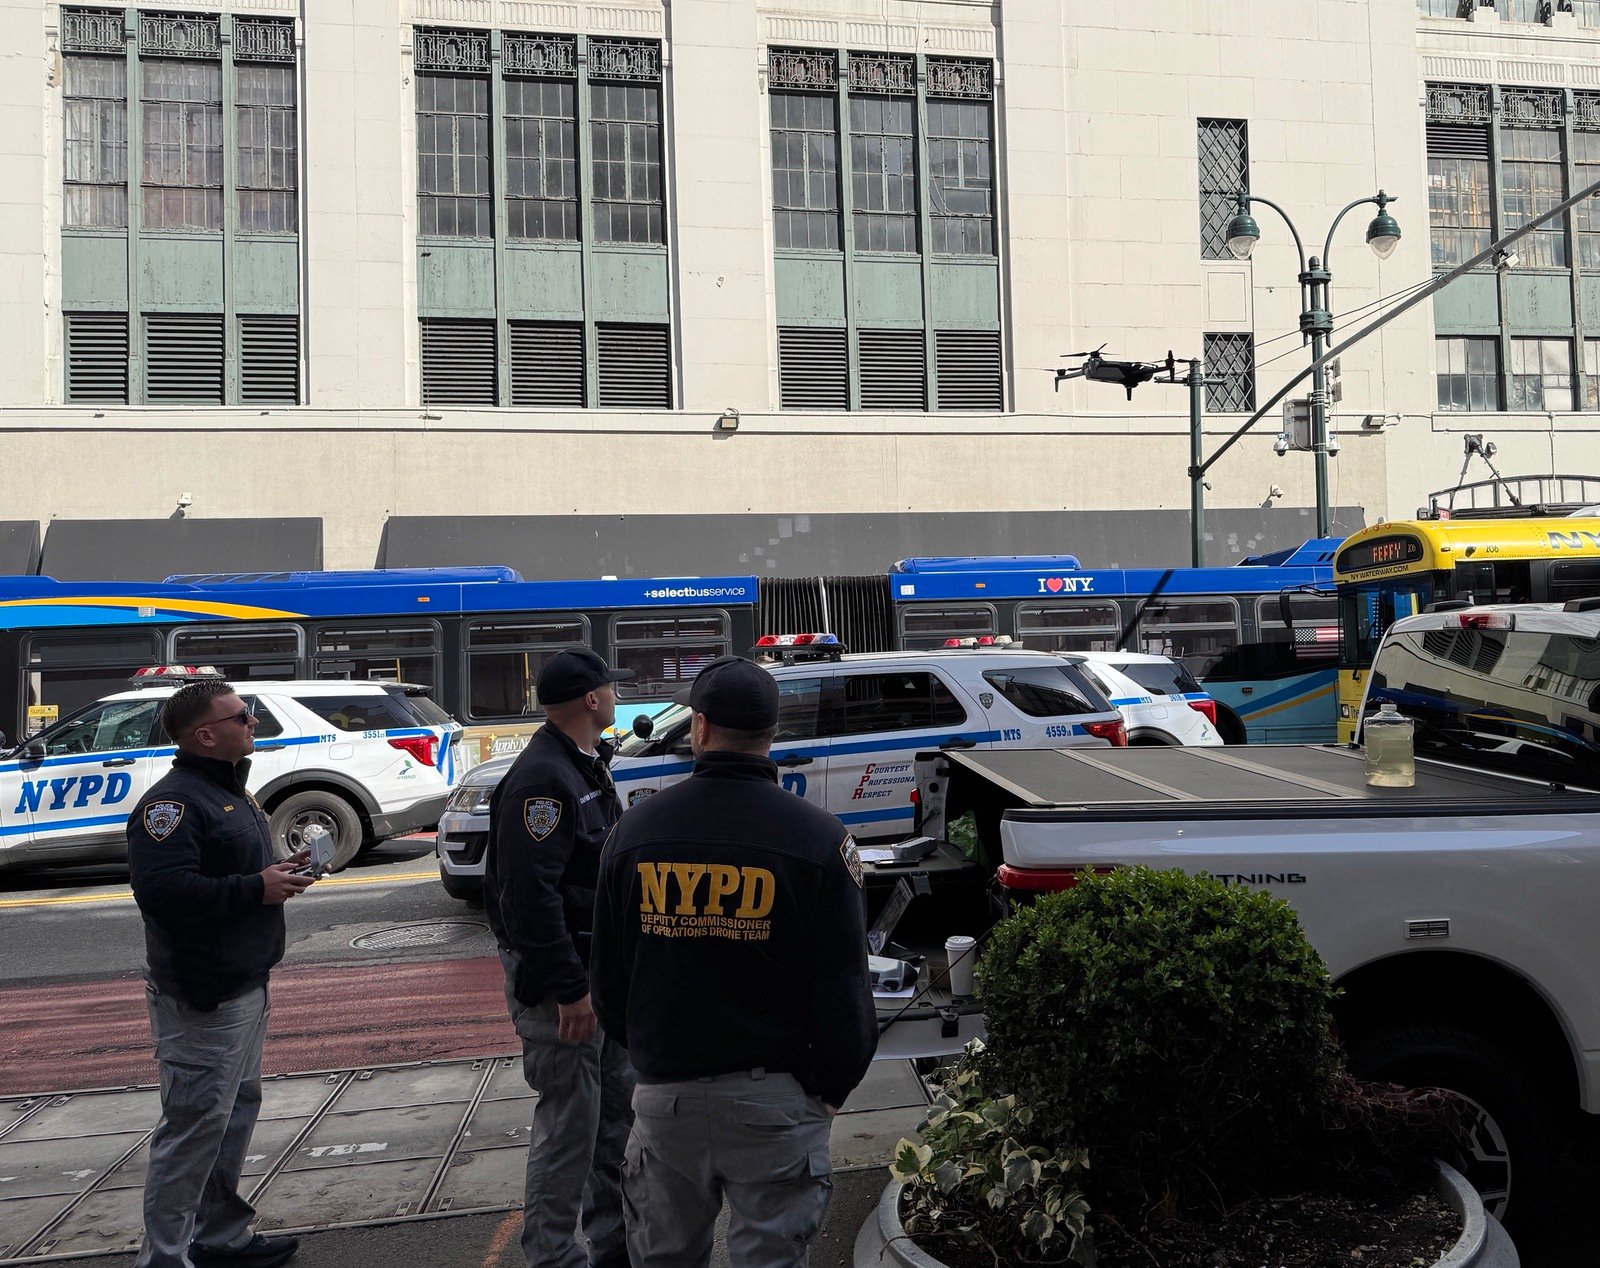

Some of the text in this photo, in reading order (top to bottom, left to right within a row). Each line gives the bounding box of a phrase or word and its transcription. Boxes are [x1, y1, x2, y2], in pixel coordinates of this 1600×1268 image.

[1037, 578, 1047, 593] I
[320, 733, 337, 743] MTS
[362, 730, 380, 739] 3551
[1003, 728, 1022, 741] MTS
[1045, 725, 1067, 738] 4559
[491, 739, 519, 753] Apply
[865, 763, 910, 775] COURTESY
[14, 772, 132, 814] NYPD
[852, 788, 893, 800] RESPECT
[637, 862, 776, 919] NYPD
[640, 913, 772, 930] DEPUTY COMMISSIONER
[641, 924, 770, 941] OF OPERATIONS DRONE TEAM
